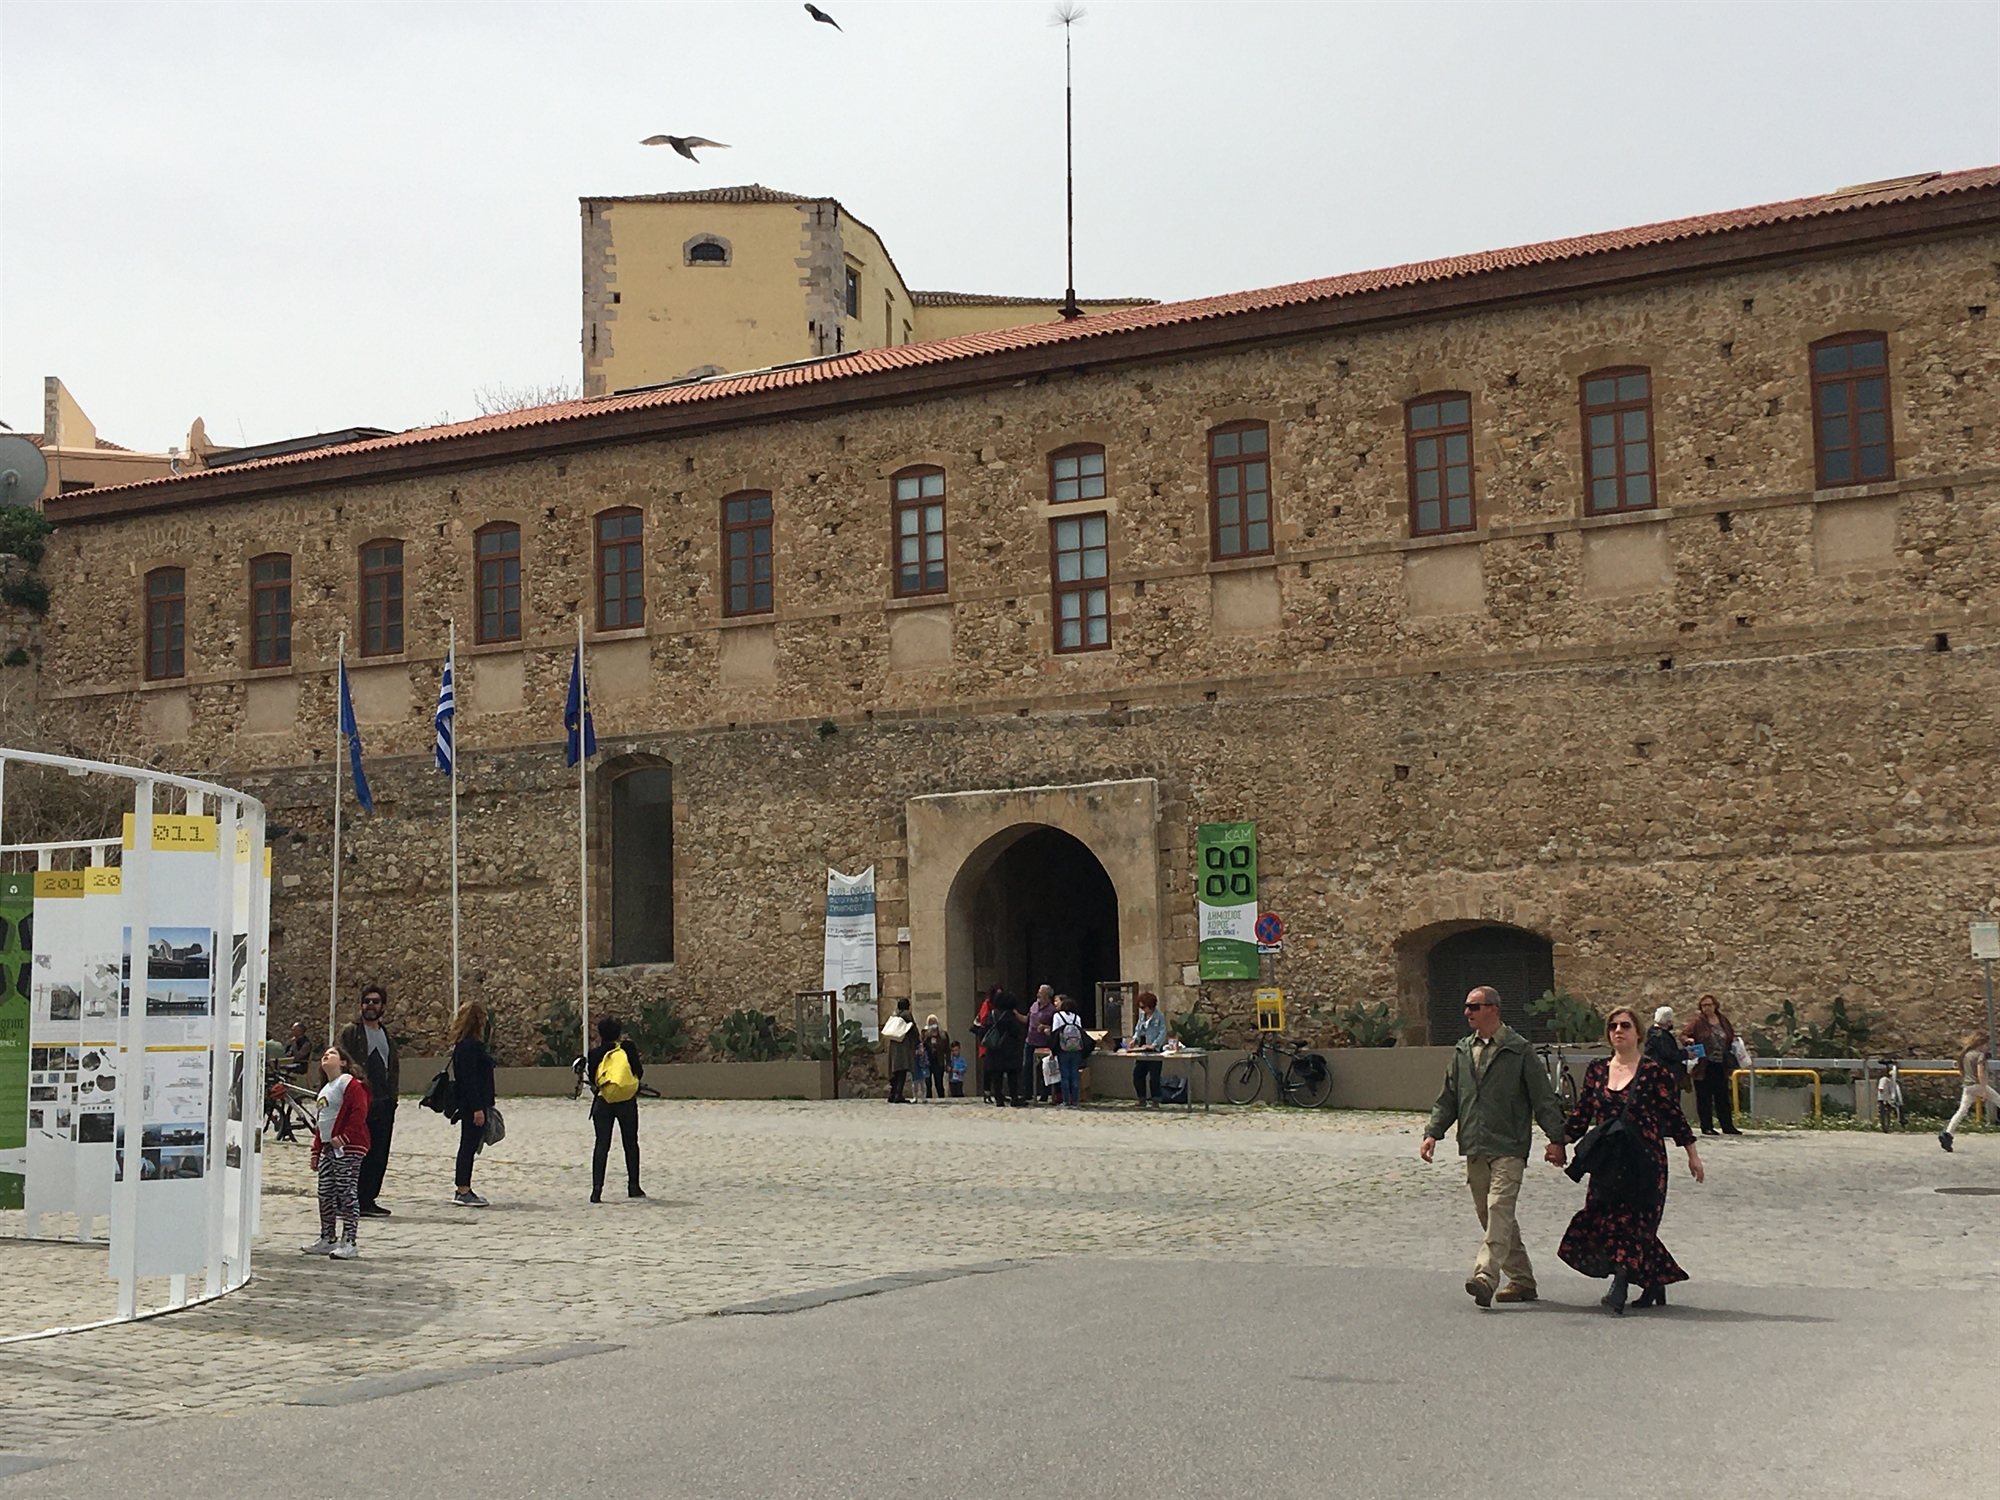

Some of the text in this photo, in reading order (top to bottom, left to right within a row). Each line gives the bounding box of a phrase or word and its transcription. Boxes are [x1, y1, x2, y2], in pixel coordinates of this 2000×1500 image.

[152, 825, 205, 842] 011
[43, 878, 84, 890] 201
[93, 874, 120, 887] 20
[1207, 910, 1242, 920] ΔΗΜΟΣΙΟΣ
[1, 1018, 24, 1029] ΟΣΙΟΣ
